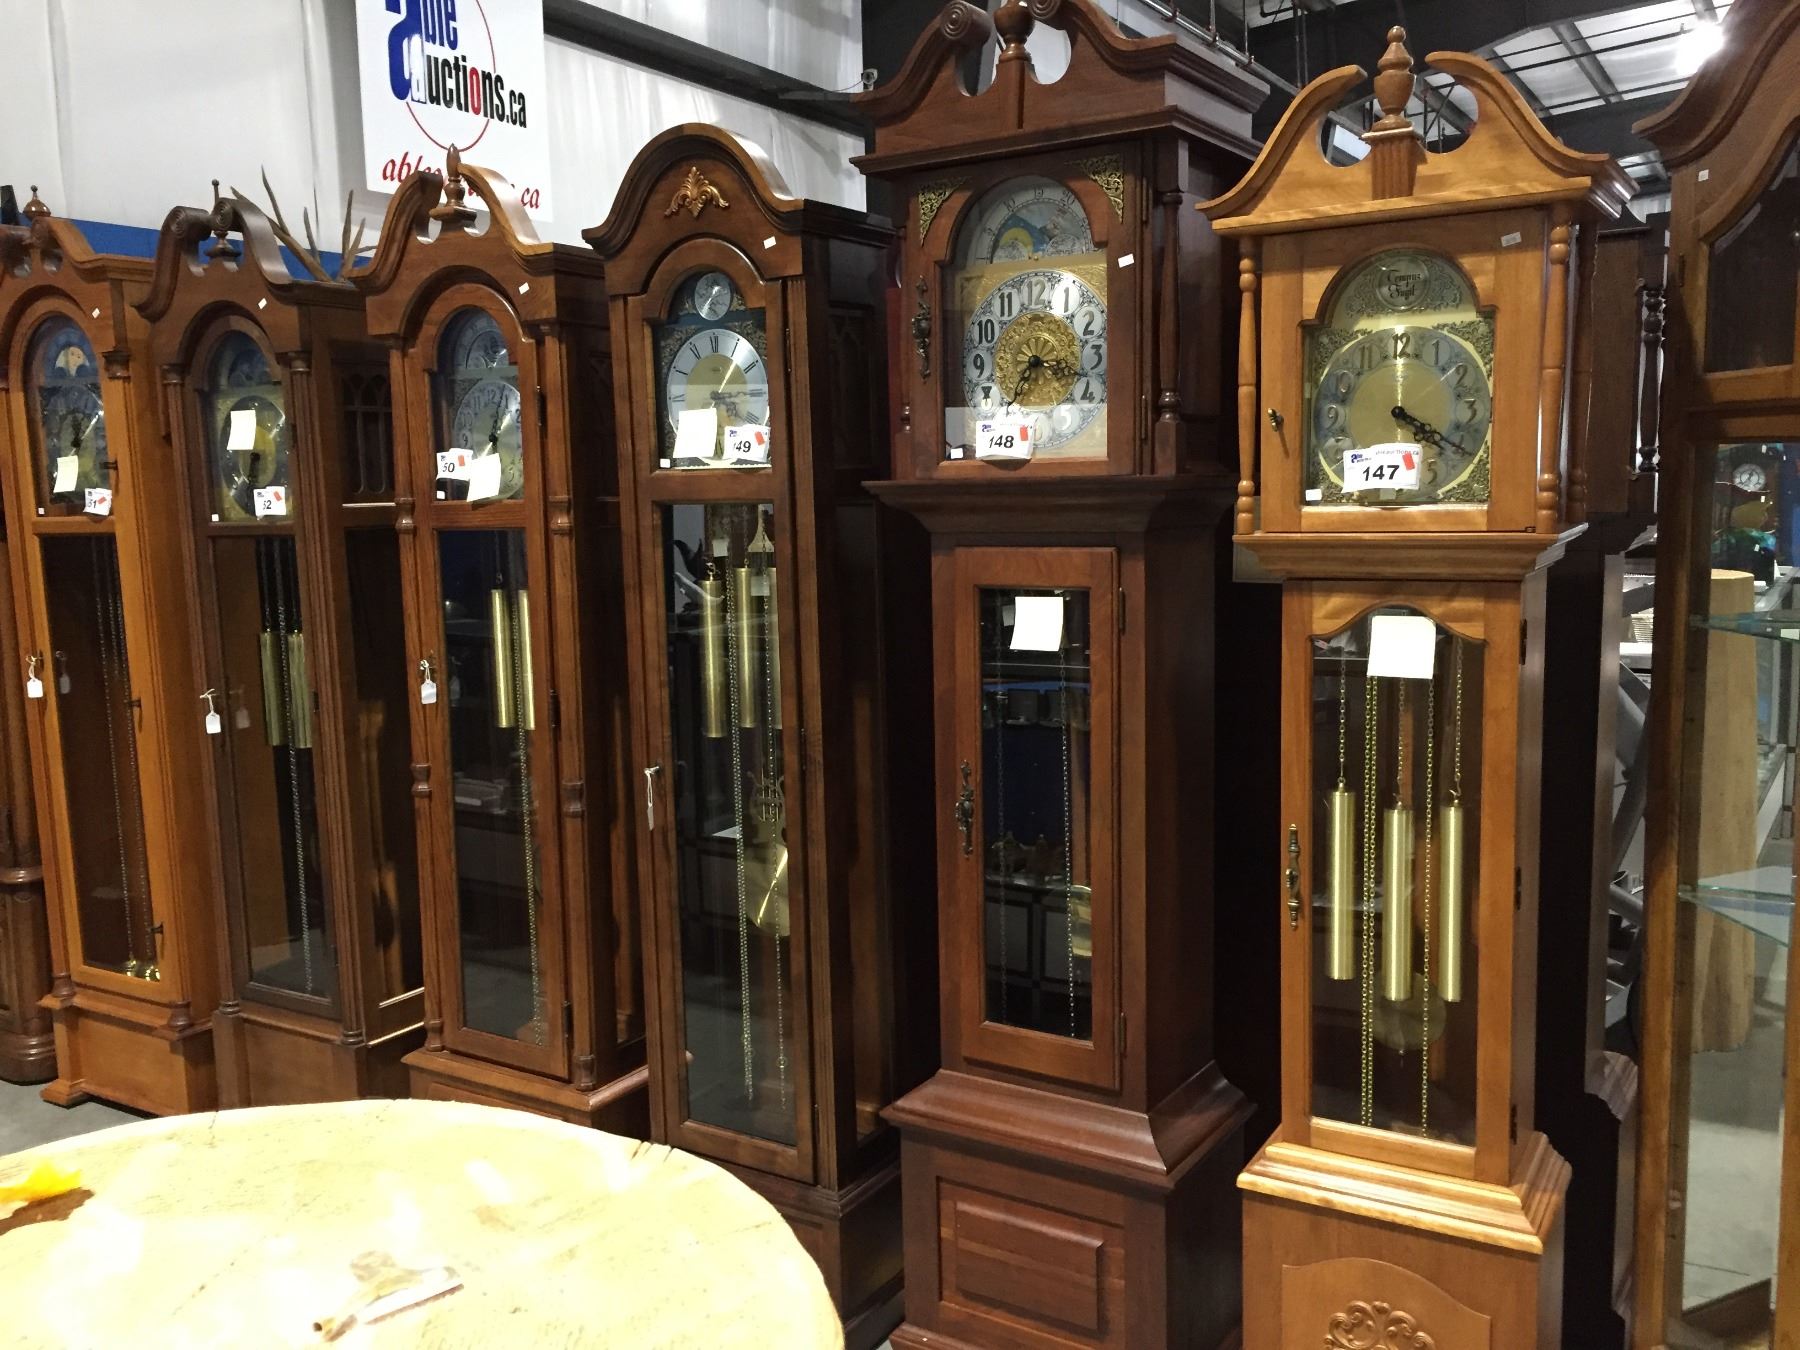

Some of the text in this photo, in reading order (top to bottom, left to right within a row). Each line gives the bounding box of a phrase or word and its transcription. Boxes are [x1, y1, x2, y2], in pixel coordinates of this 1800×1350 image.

[999, 291, 1013, 318] 11
[1026, 278, 1046, 308] 12
[1063, 286, 1070, 313] 1
[977, 318, 995, 345] 10
[1082, 311, 1096, 337] 2
[1090, 344, 1103, 374] 3
[1391, 332, 1411, 360] 12
[1431, 339, 1440, 366] 1
[972, 353, 985, 378] 9
[1454, 362, 1468, 390] 2
[1080, 377, 1096, 403] 4
[1325, 404, 1339, 430] 9
[1463, 398, 1477, 425] 3
[988, 434, 1015, 449] 148
[1362, 464, 1400, 482] 147
